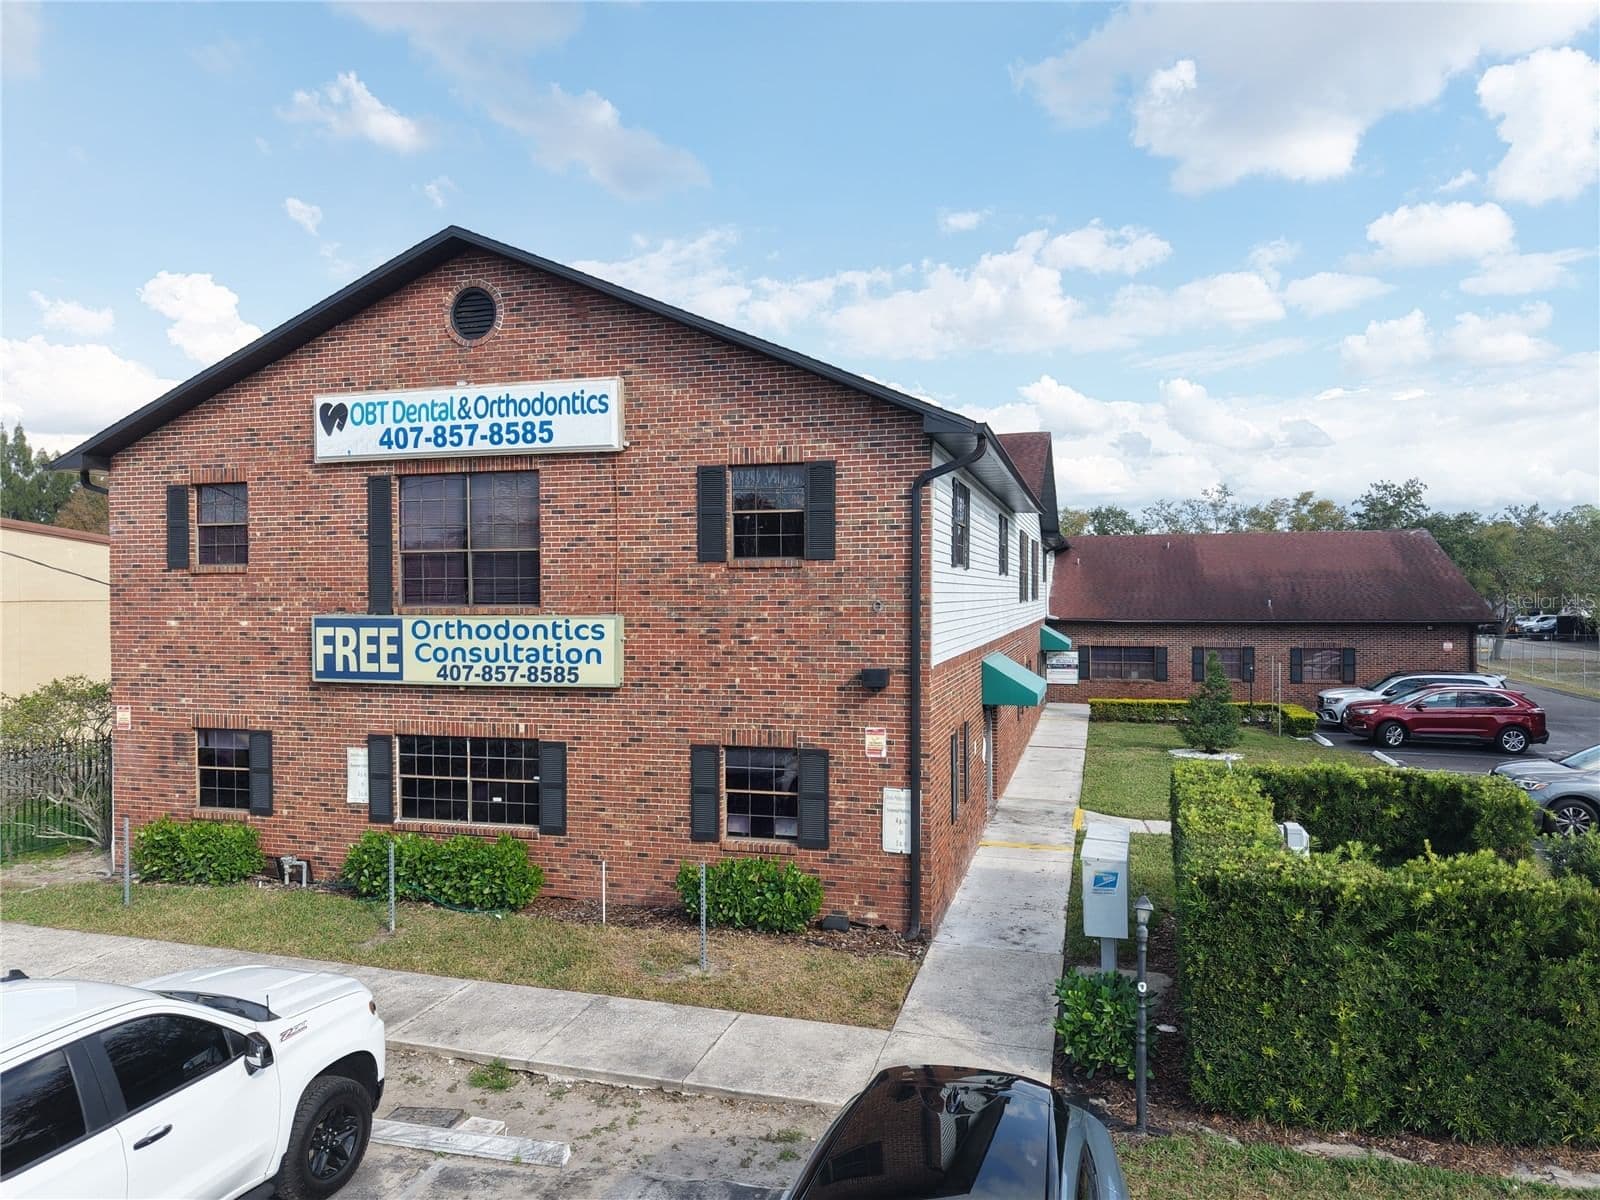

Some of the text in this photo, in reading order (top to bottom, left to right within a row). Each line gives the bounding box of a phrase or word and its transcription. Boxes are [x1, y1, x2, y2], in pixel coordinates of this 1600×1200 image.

[350, 389, 609, 427] OBT Dental & Orthodontics
[379, 420, 554, 449] 407-857-8585
[411, 619, 606, 641] Orthodontics
[315, 626, 400, 673] FREE
[415, 642, 602, 665] Consultation
[436, 664, 580, 684] 407-857-8585
